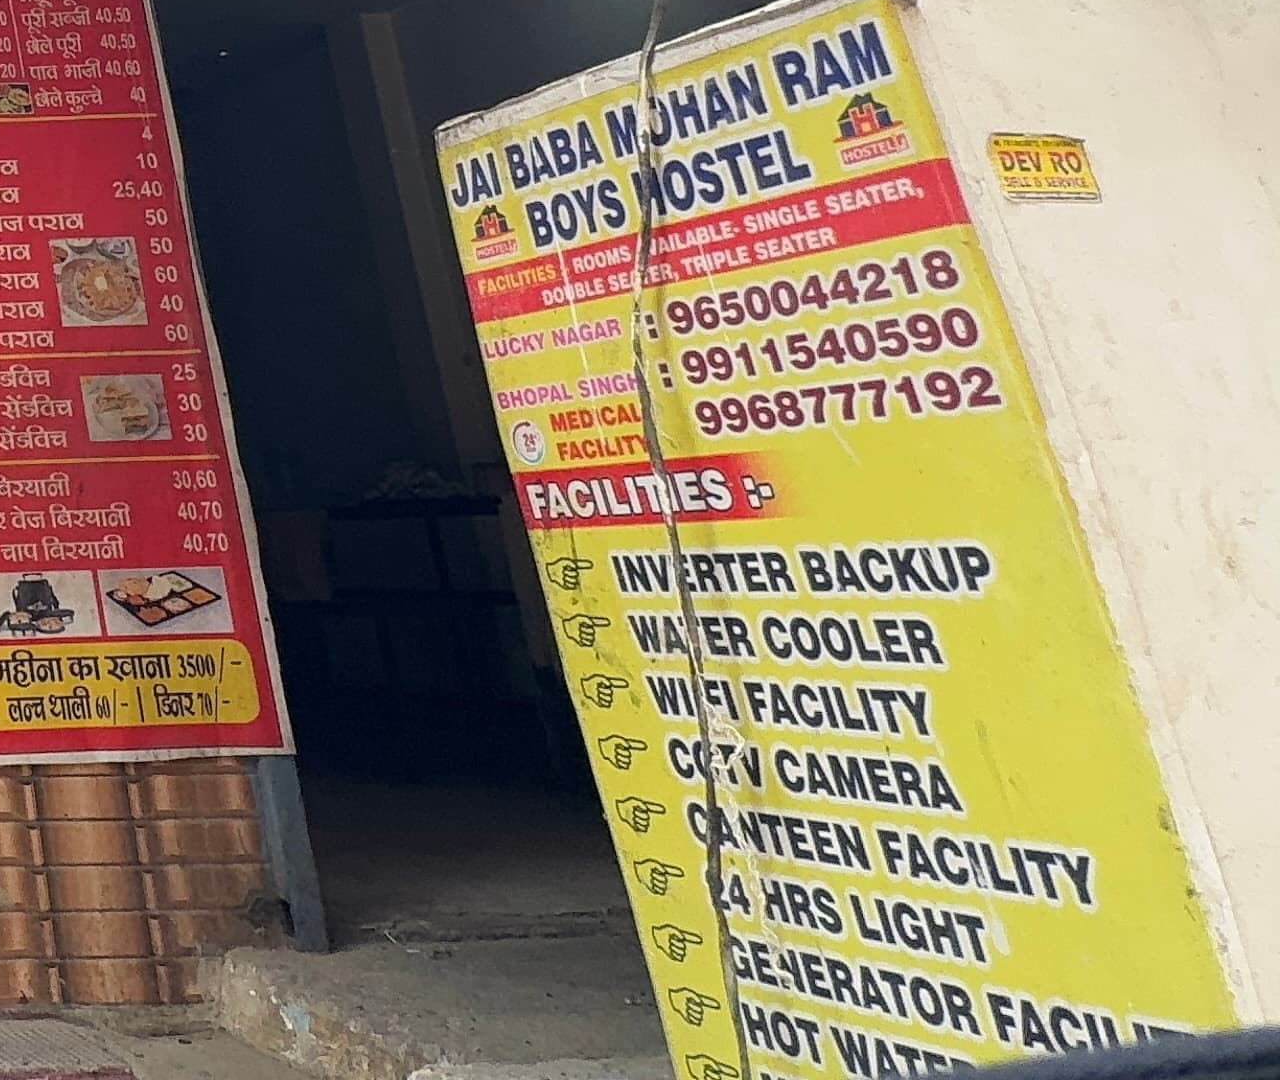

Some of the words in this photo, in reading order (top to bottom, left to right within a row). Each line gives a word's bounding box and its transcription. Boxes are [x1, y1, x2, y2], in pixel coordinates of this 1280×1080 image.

[56, 32, 82, 58] पूरी
[0, 63, 16, 79] 20
[451, 152, 503, 208] JAI
[504, 120, 604, 191] BABA
[771, 21, 893, 107] RAM
[136, 152, 158, 170] 10
[997, 151, 1042, 172] DEV
[1048, 151, 1083, 175] RO
[112, 181, 163, 199] 25,40
[525, 178, 627, 248] BOYS
[631, 130, 813, 216] HOSTEL
[145, 208, 168, 226] 50
[150, 237, 173, 255] 50
[477, 264, 557, 296] FACILITIES
[572, 245, 633, 275] ROOMS
[743, 200, 821, 235] SINGLE
[824, 177, 925, 215] SEATER,
[154, 266, 178, 283] 60
[541, 277, 607, 307] DOUBLE
[681, 246, 751, 283] TRIPLE
[753, 227, 838, 263] SEATER
[160, 294, 184, 313] 40
[483, 332, 545, 360] LUCKY
[551, 319, 622, 347] NAGAR
[666, 249, 961, 336] 9650044218
[164, 324, 189, 342] 60
[171, 363, 197, 382] 25
[496, 383, 574, 411] BHOPAL
[579, 373, 640, 398] SINGH
[681, 307, 979, 385] 9911540590
[177, 393, 202, 412] 30
[695, 366, 1002, 437] 9968777192
[183, 423, 208, 442] 30
[549, 402, 643, 433] MEDICAL
[556, 433, 650, 462] FACILITY
[173, 470, 218, 490] 30,60
[523, 469, 734, 521] FACILITIES
[9, 505, 46, 530] वेज
[48, 501, 132, 529] बिरयानी
[178, 501, 223, 522] 40,70
[0, 542, 39, 563] चाप
[183, 532, 229, 555] 40,70
[611, 551, 798, 594] INVERTER
[799, 545, 993, 594] BACKUP
[761, 616, 945, 666] COOLER
[67, 656, 101, 681] का
[105, 654, 172, 682] खाना
[49, 685, 93, 721] थाली
[153, 683, 196, 718] डिनर
[743, 682, 932, 737] FACILITY
[775, 748, 966, 814] CAMERA
[687, 801, 872, 872] CANTEEN
[877, 829, 1094, 906] FACILITY
[762, 874, 844, 937] HRS
[850, 895, 989, 964] LIGHT
[730, 937, 982, 1036] GENERATOR
[740, 1001, 826, 1066] HOT
